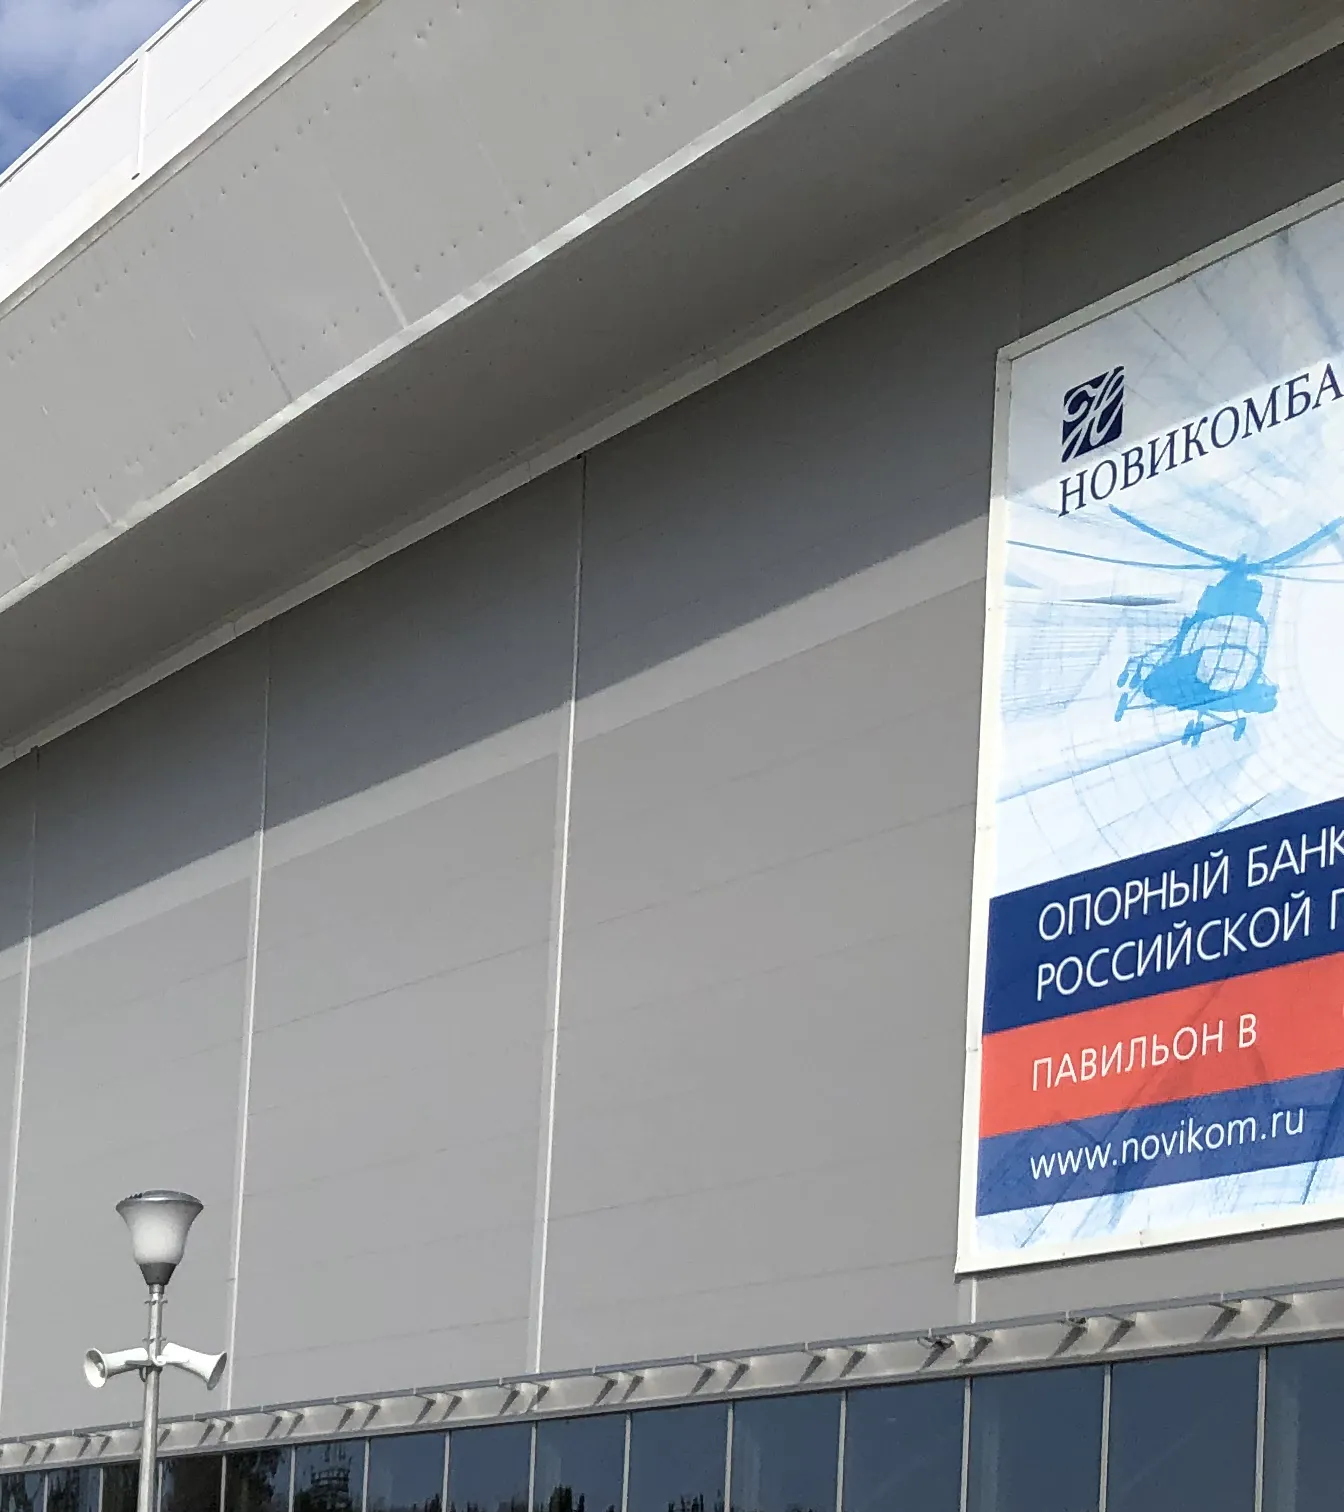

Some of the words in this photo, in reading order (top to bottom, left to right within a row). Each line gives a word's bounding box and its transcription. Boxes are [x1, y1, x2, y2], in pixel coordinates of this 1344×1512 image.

[1058, 363, 1344, 517] НОВИКОМБА
[1038, 849, 1229, 941] ОПОРНЫЙ
[1037, 891, 1311, 1001] РОССИЙСКОЙ
[1032, 1019, 1223, 1091] ПАВИЛЬОН
[1238, 1013, 1257, 1048] В
[1030, 1108, 1304, 1180] www.novikom.ru
